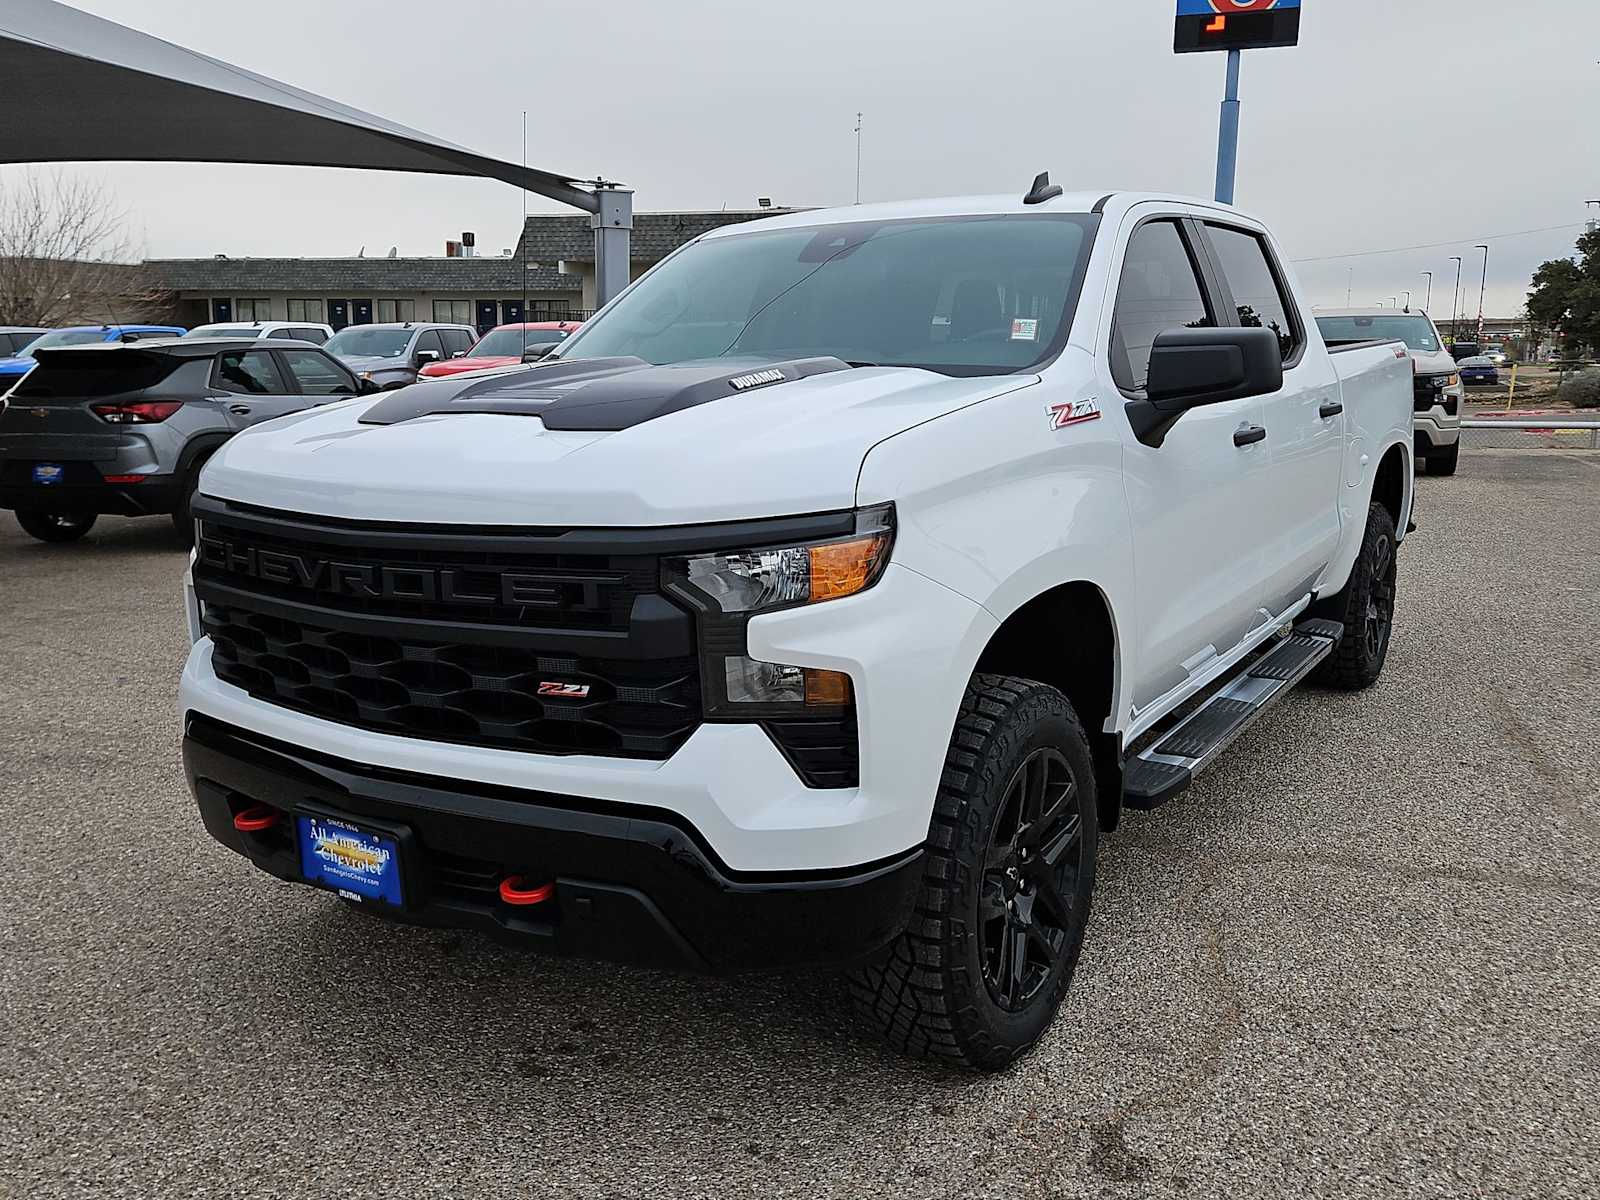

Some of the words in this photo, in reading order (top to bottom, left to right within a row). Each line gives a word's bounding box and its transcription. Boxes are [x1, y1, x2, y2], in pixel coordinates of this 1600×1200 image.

[730, 369, 785, 389] DURAMAX
[1044, 397, 1102, 431] Z71
[200, 536, 630, 611] CHEVROLET
[537, 681, 590, 697] Z71
[310, 826, 327, 843] All
[329, 831, 391, 861] American
[320, 845, 383, 876] Chevrolet
